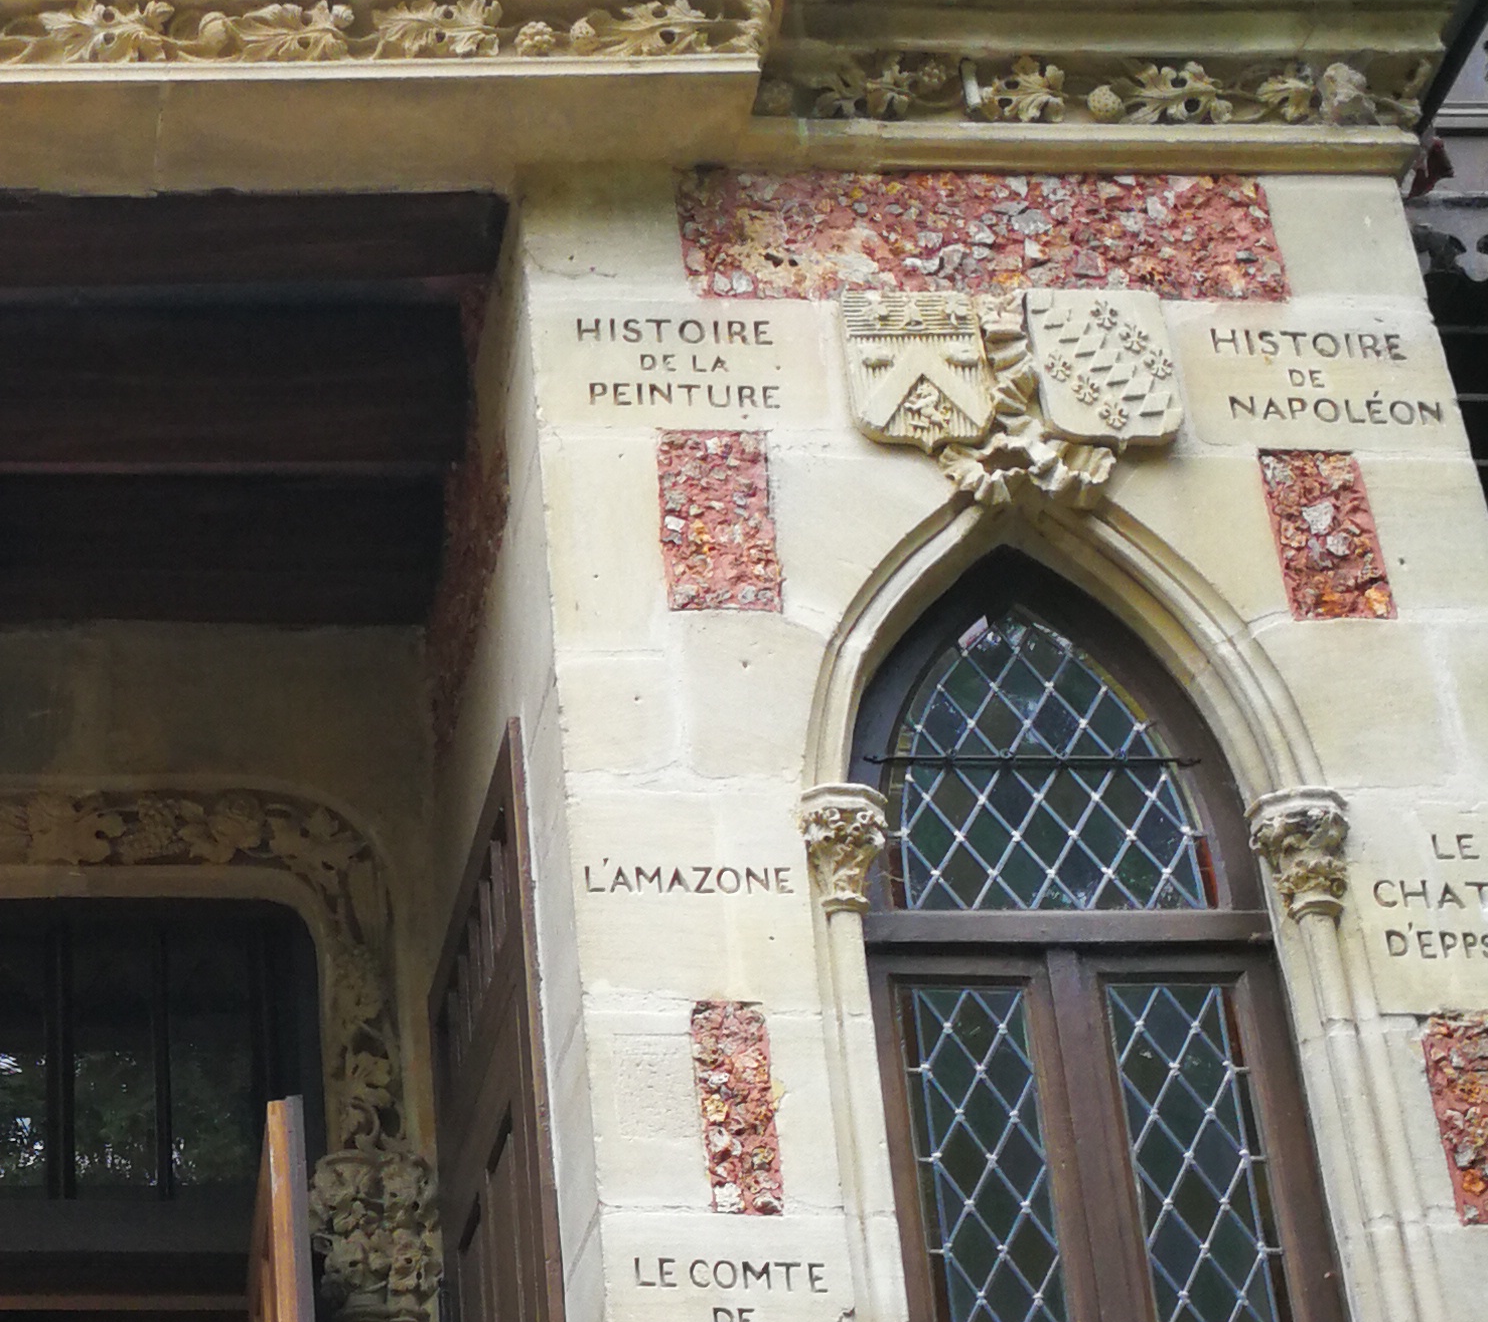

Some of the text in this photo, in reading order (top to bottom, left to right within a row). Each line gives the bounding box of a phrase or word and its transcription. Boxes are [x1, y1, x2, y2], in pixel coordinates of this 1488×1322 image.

[575, 317, 774, 346] HISTOIRE
[1210, 328, 1408, 361] HISTOIRE
[640, 353, 730, 373] DE LA
[1287, 368, 1326, 389] DE
[588, 381, 782, 410] PEINTURE
[1228, 389, 1443, 426] NAPOLÉON
[1431, 833, 1480, 861] LE
[583, 857, 796, 895] L'AMAZONE
[633, 1256, 829, 1294] LE COMTE
